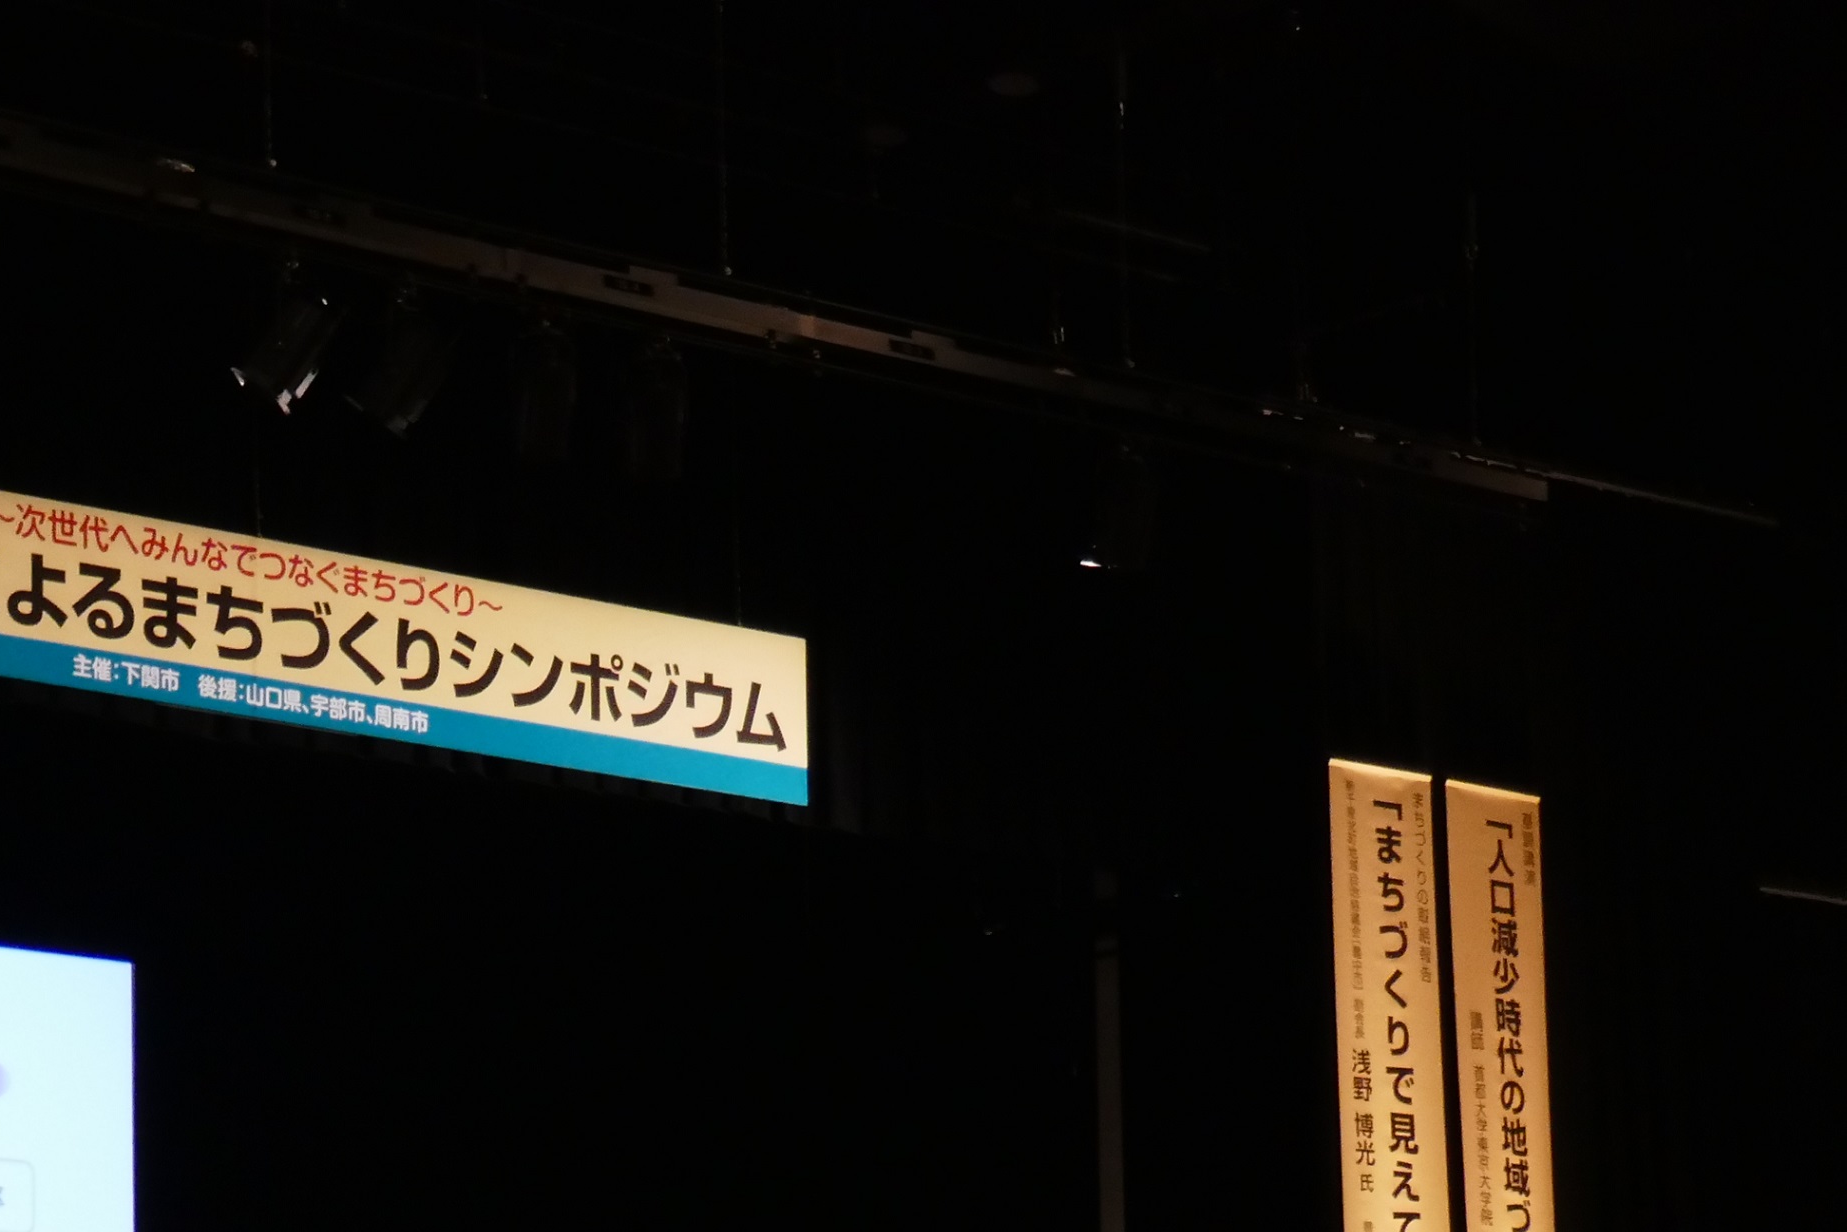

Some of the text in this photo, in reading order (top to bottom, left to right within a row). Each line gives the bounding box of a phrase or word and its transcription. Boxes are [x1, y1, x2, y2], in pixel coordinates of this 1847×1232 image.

[1352, 1049, 1372, 1102] 浅野
[1354, 1112, 1375, 1166] 博光
[1360, 1173, 1375, 1192] 氏
